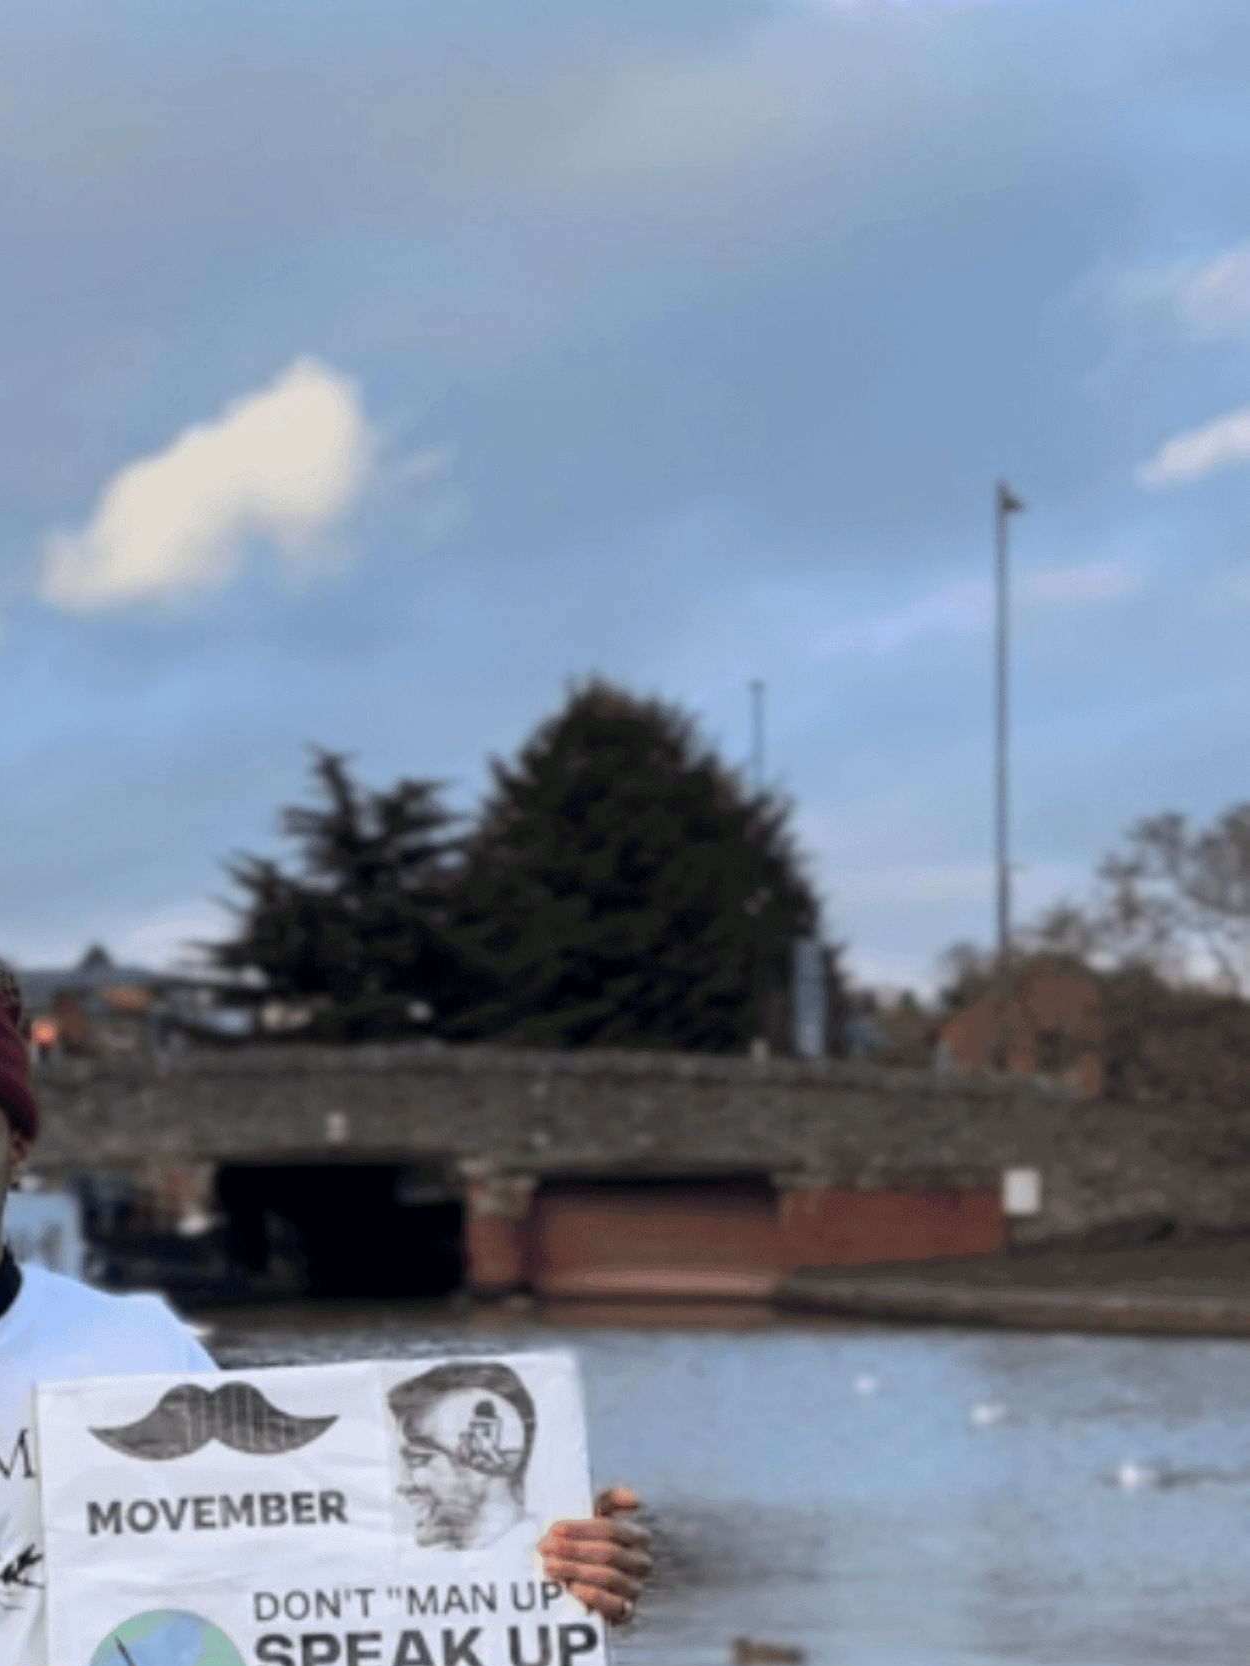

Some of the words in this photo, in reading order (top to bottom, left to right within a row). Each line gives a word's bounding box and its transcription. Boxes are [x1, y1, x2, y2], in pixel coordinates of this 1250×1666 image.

[87, 1489, 349, 1535] MOVEMBER
[253, 1588, 376, 1622] DON'T
[387, 1581, 498, 1617] "MAN
